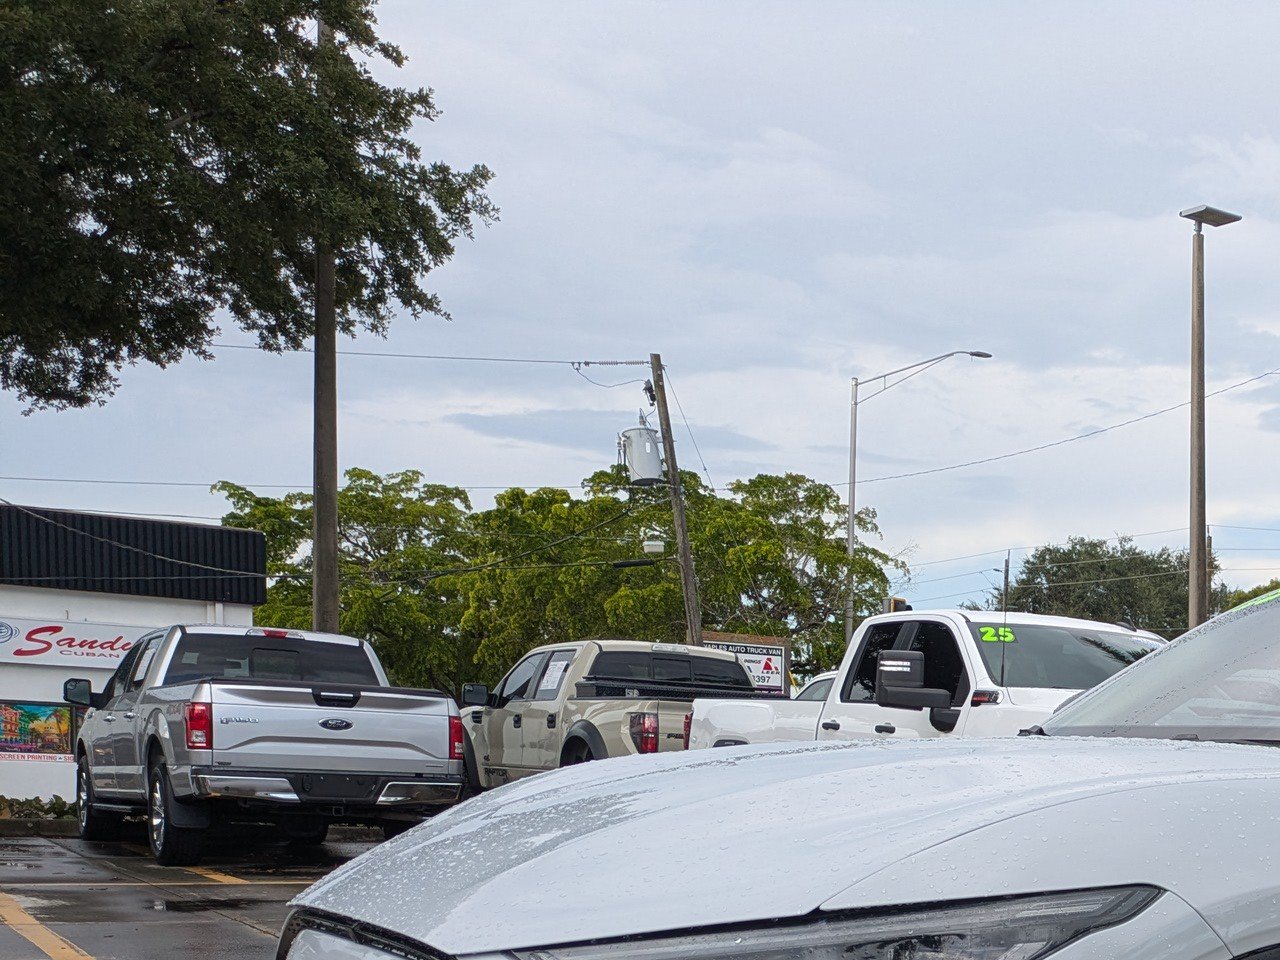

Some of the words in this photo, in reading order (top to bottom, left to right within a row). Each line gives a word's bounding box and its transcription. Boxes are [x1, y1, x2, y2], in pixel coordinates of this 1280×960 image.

[979, 626, 1016, 643] 25
[59, 649, 120, 659] CUBAN
[728, 645, 746, 653] AUTO
[746, 646, 767, 654] TRUCK
